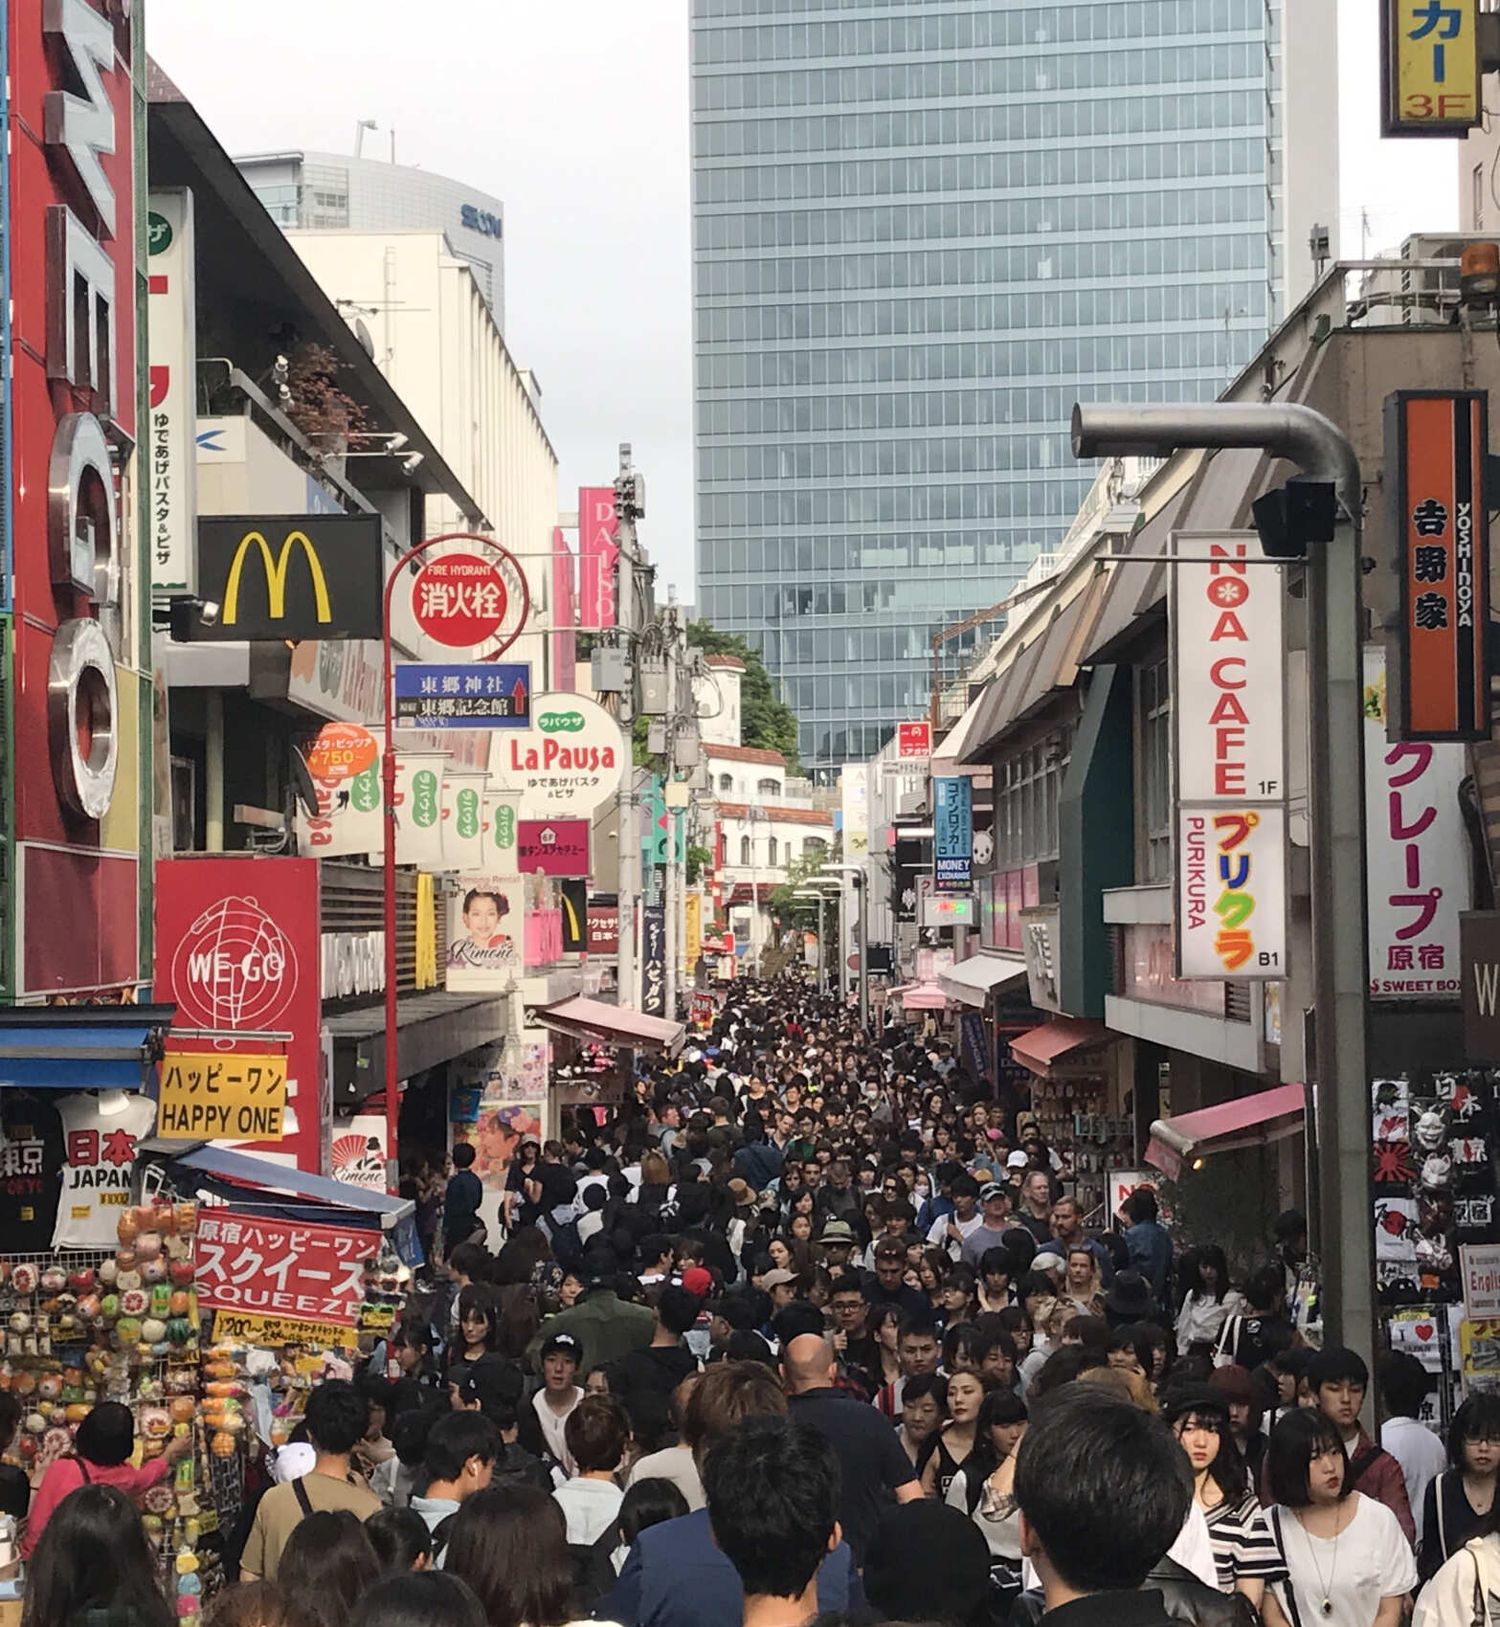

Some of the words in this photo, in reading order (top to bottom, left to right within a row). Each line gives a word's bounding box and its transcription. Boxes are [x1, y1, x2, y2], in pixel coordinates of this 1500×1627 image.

[1405, 94, 1471, 119] 3F
[427, 565, 448, 577] FIRE
[450, 564, 492, 577] HYDRANT
[594, 502, 614, 617] DAISO
[1413, 499, 1449, 630] 吉野家
[1457, 501, 1474, 627] YOSHINOYA
[420, 581, 501, 620] 消火栓
[1206, 544, 1250, 642] NOA
[419, 675, 504, 694] 東郷神社
[420, 697, 509, 716] 東郷記念館
[1208, 657, 1250, 795] CAFE
[511, 739, 539, 771] La
[543, 738, 615, 773] Pausa
[1257, 780, 1278, 795] 1F
[1384, 741, 1444, 940] クレープ
[937, 859, 970, 871] MONEY
[1187, 816, 1206, 930] PURIKURA
[1213, 810, 1259, 972] プリクラ
[1258, 952, 1279, 966] B1
[1387, 944, 1445, 971] 原宿
[1383, 980, 1434, 992] SWEET
[165, 1063, 284, 1095] ハッピーワン
[162, 1104, 232, 1132] HAPPY
[238, 1106, 280, 1134] ONE
[68, 1128, 138, 1168] 日本
[69, 1169, 132, 1189] JAPAN
[197, 1218, 376, 1260] 原宿ハッピーワン
